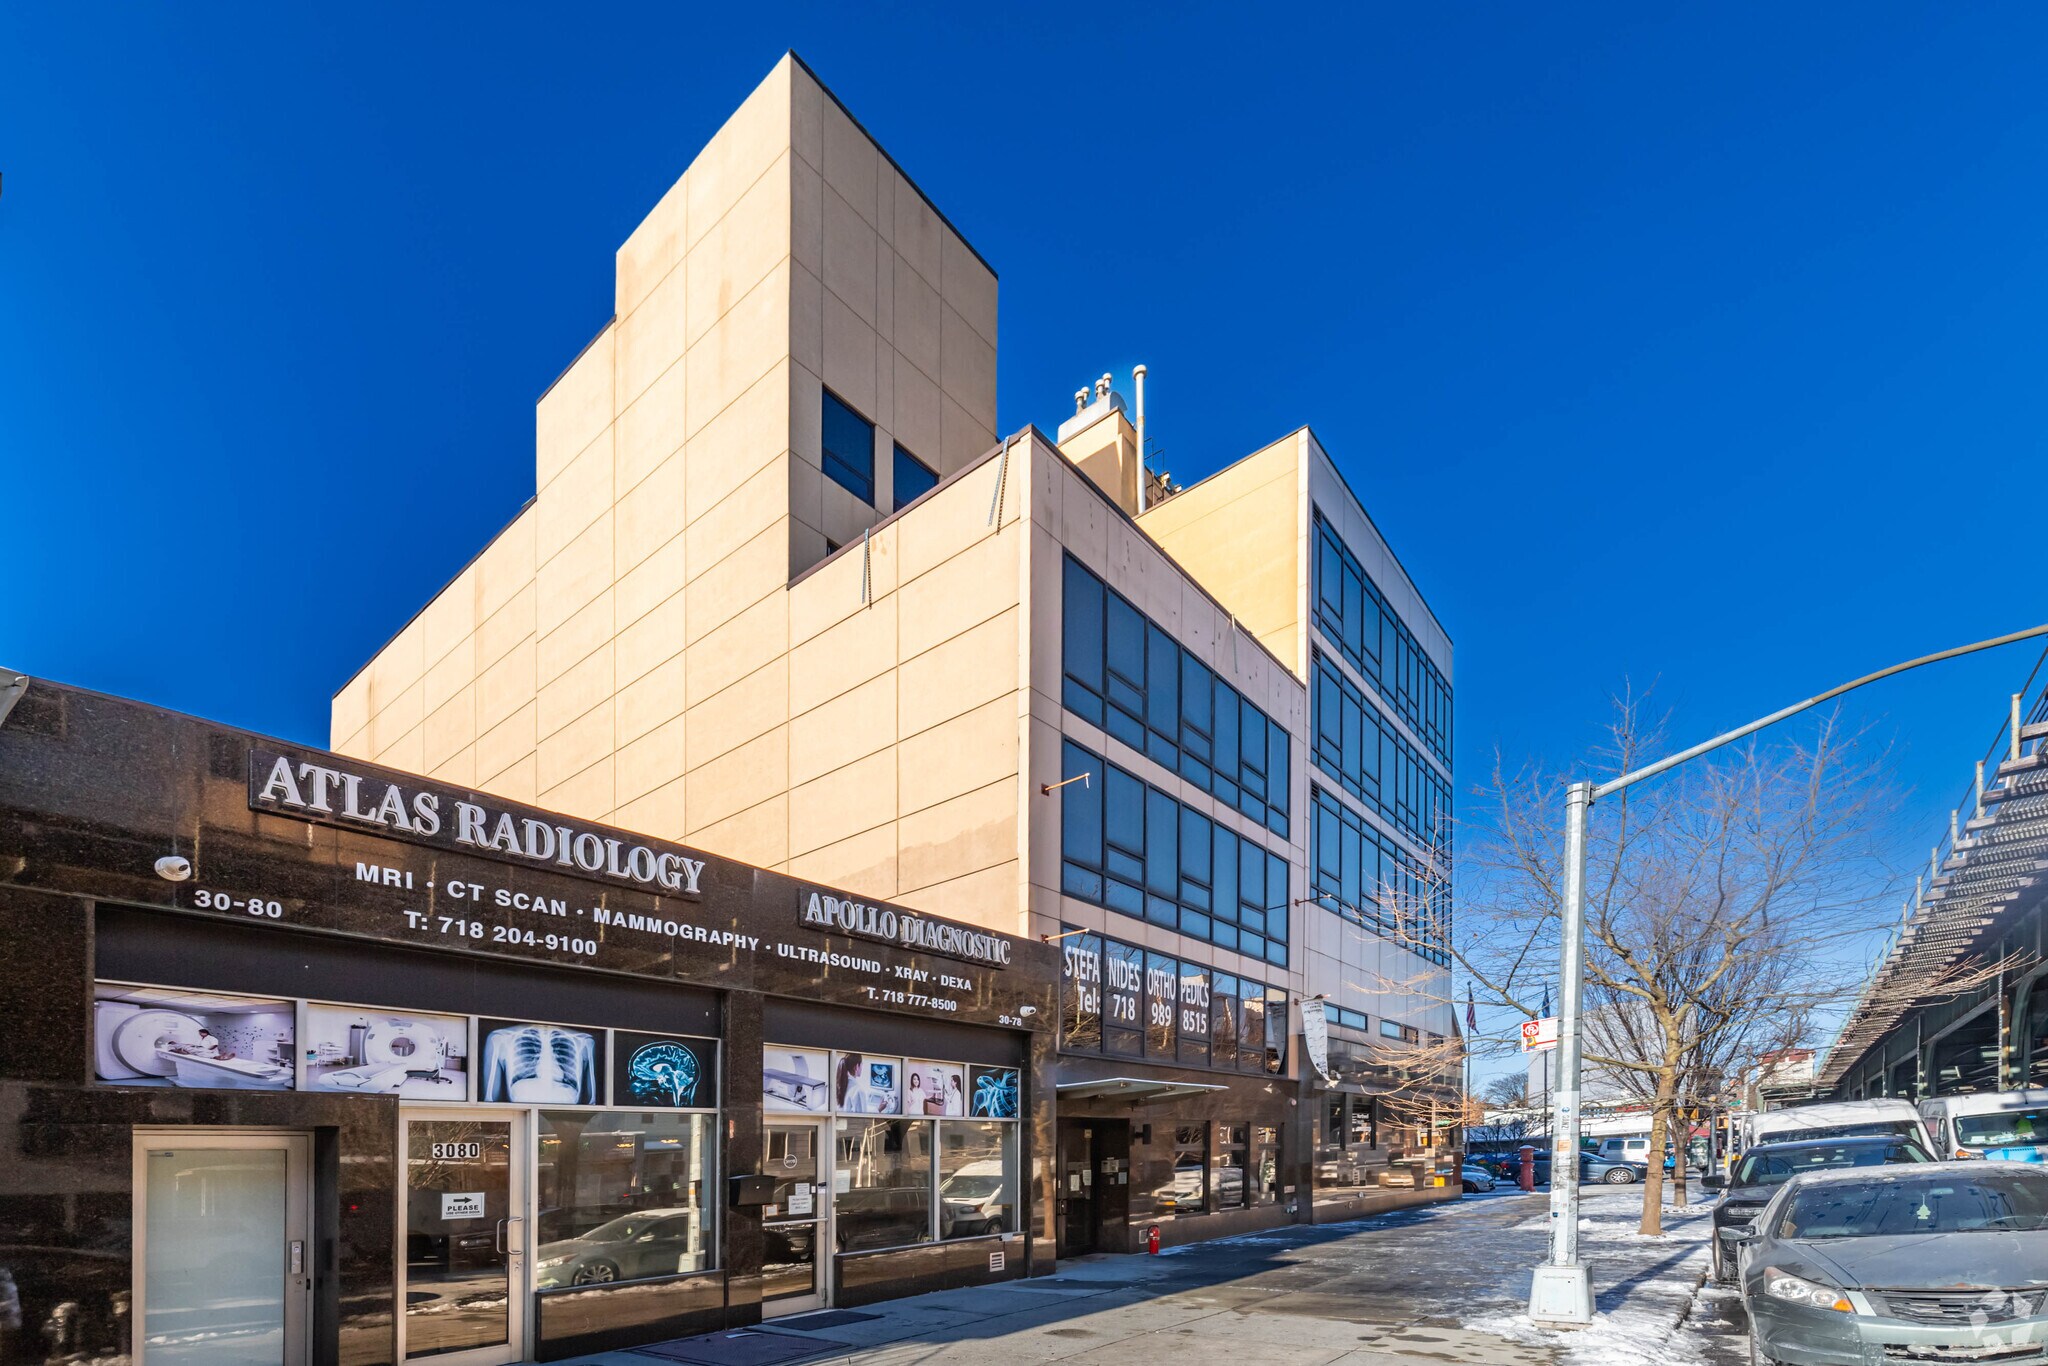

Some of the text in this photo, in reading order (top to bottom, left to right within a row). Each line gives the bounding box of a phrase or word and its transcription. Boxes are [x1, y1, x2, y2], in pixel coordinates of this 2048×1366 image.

[259, 757, 706, 894] ATLAS RADIOLOGY
[194, 890, 283, 918] 30-80
[356, 862, 973, 991] MRI CT SCAN MAMMOGRAPHY ULTRASOUND XRAY DEXA
[403, 910, 598, 956] T: 718 204-9100
[805, 892, 1011, 965] APOLLO DIAGNOSTIC
[867, 987, 958, 1012] T. 718 777-8500
[1078, 985, 1207, 1034] Tel: 718 989 8515
[999, 1014, 1022, 1027] 30-78
[434, 1143, 479, 1158] 3080
[447, 1204, 479, 1212] PLEASE
